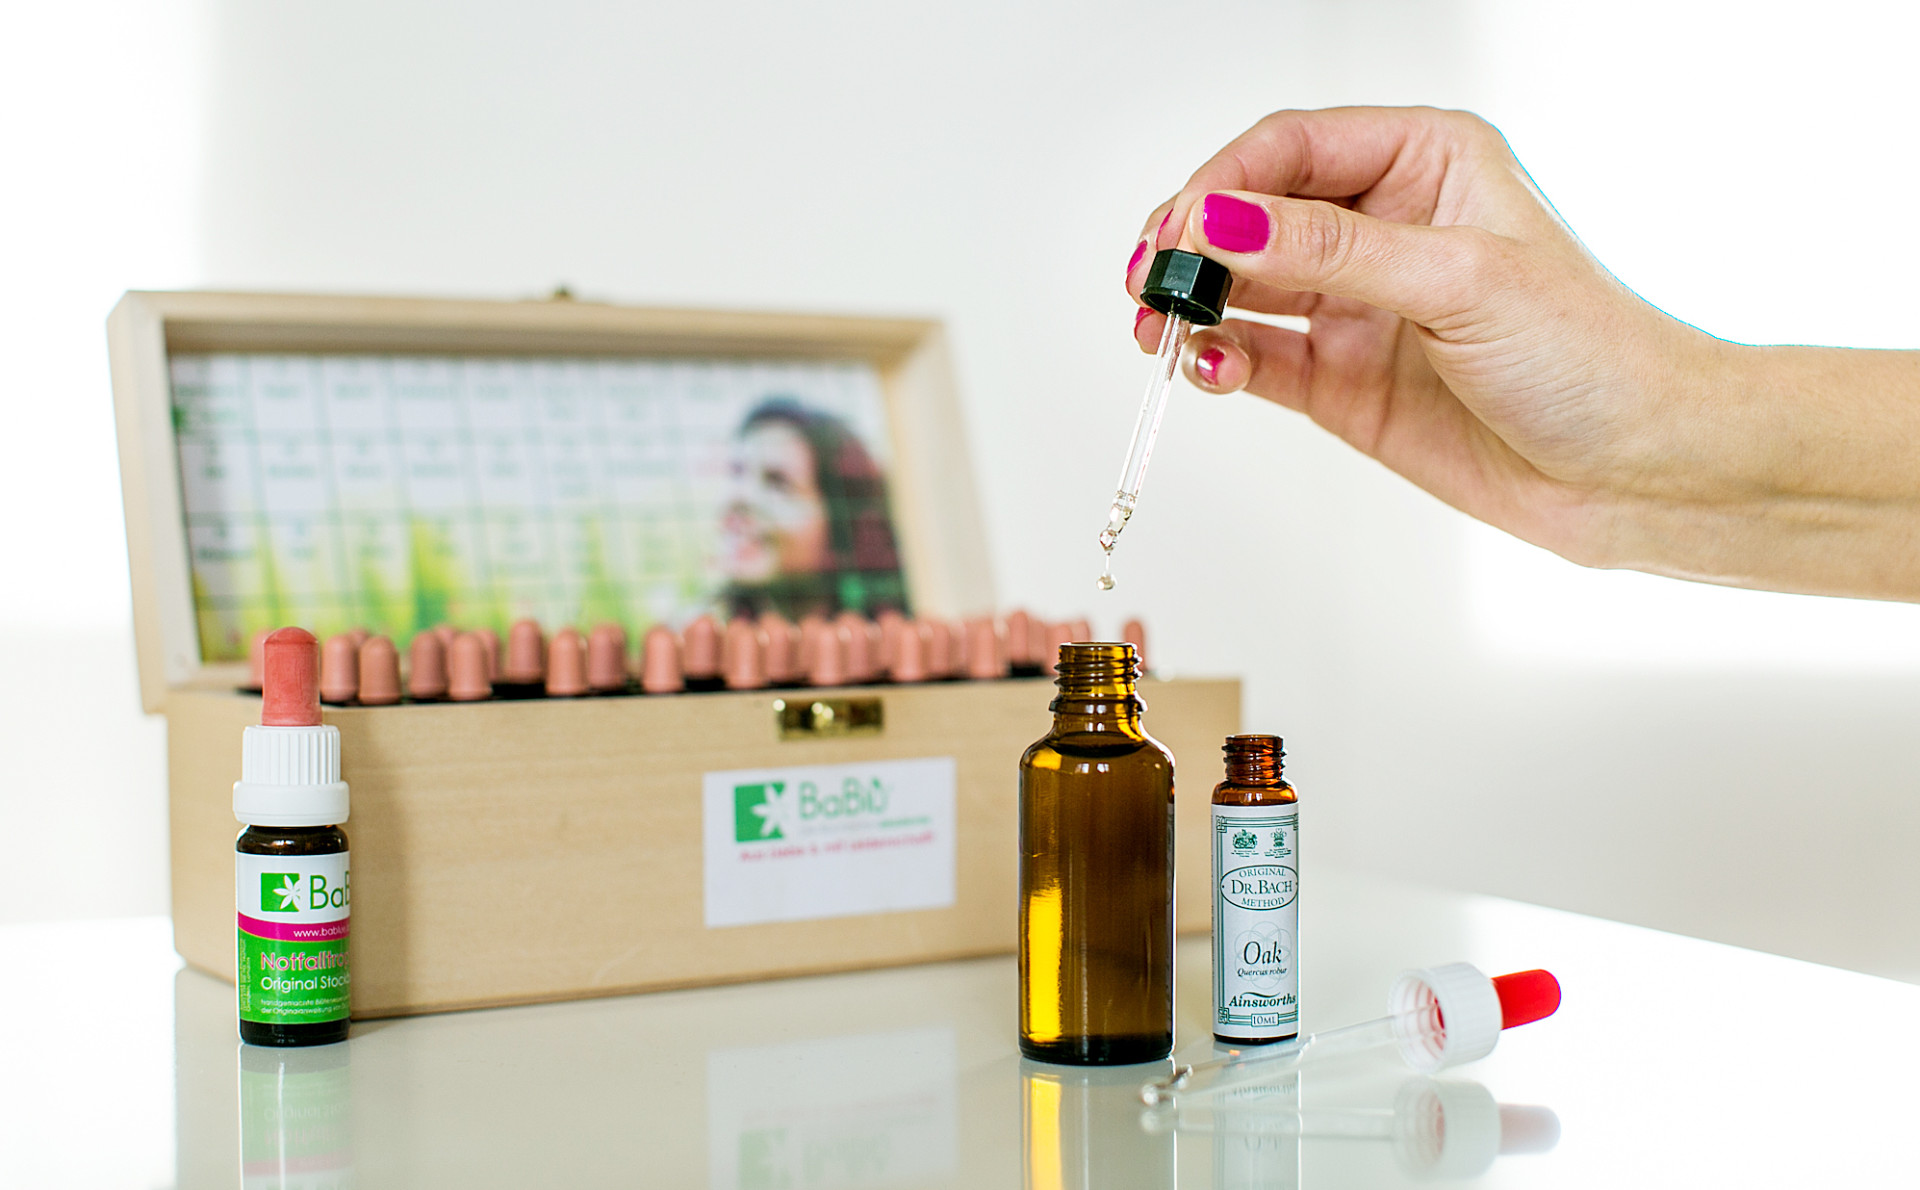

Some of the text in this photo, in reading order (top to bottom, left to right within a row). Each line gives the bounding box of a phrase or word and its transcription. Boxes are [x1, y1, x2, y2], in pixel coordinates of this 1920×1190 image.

[1239, 868, 1286, 878] ORIGINAL
[1241, 896, 1285, 908] METHOD
[1243, 940, 1282, 965] Oak
[1237, 967, 1268, 978] Quercus
[261, 976, 318, 994] Original
[1229, 992, 1296, 1008] Ainsworths
[1252, 1016, 1277, 1025] 10ML
